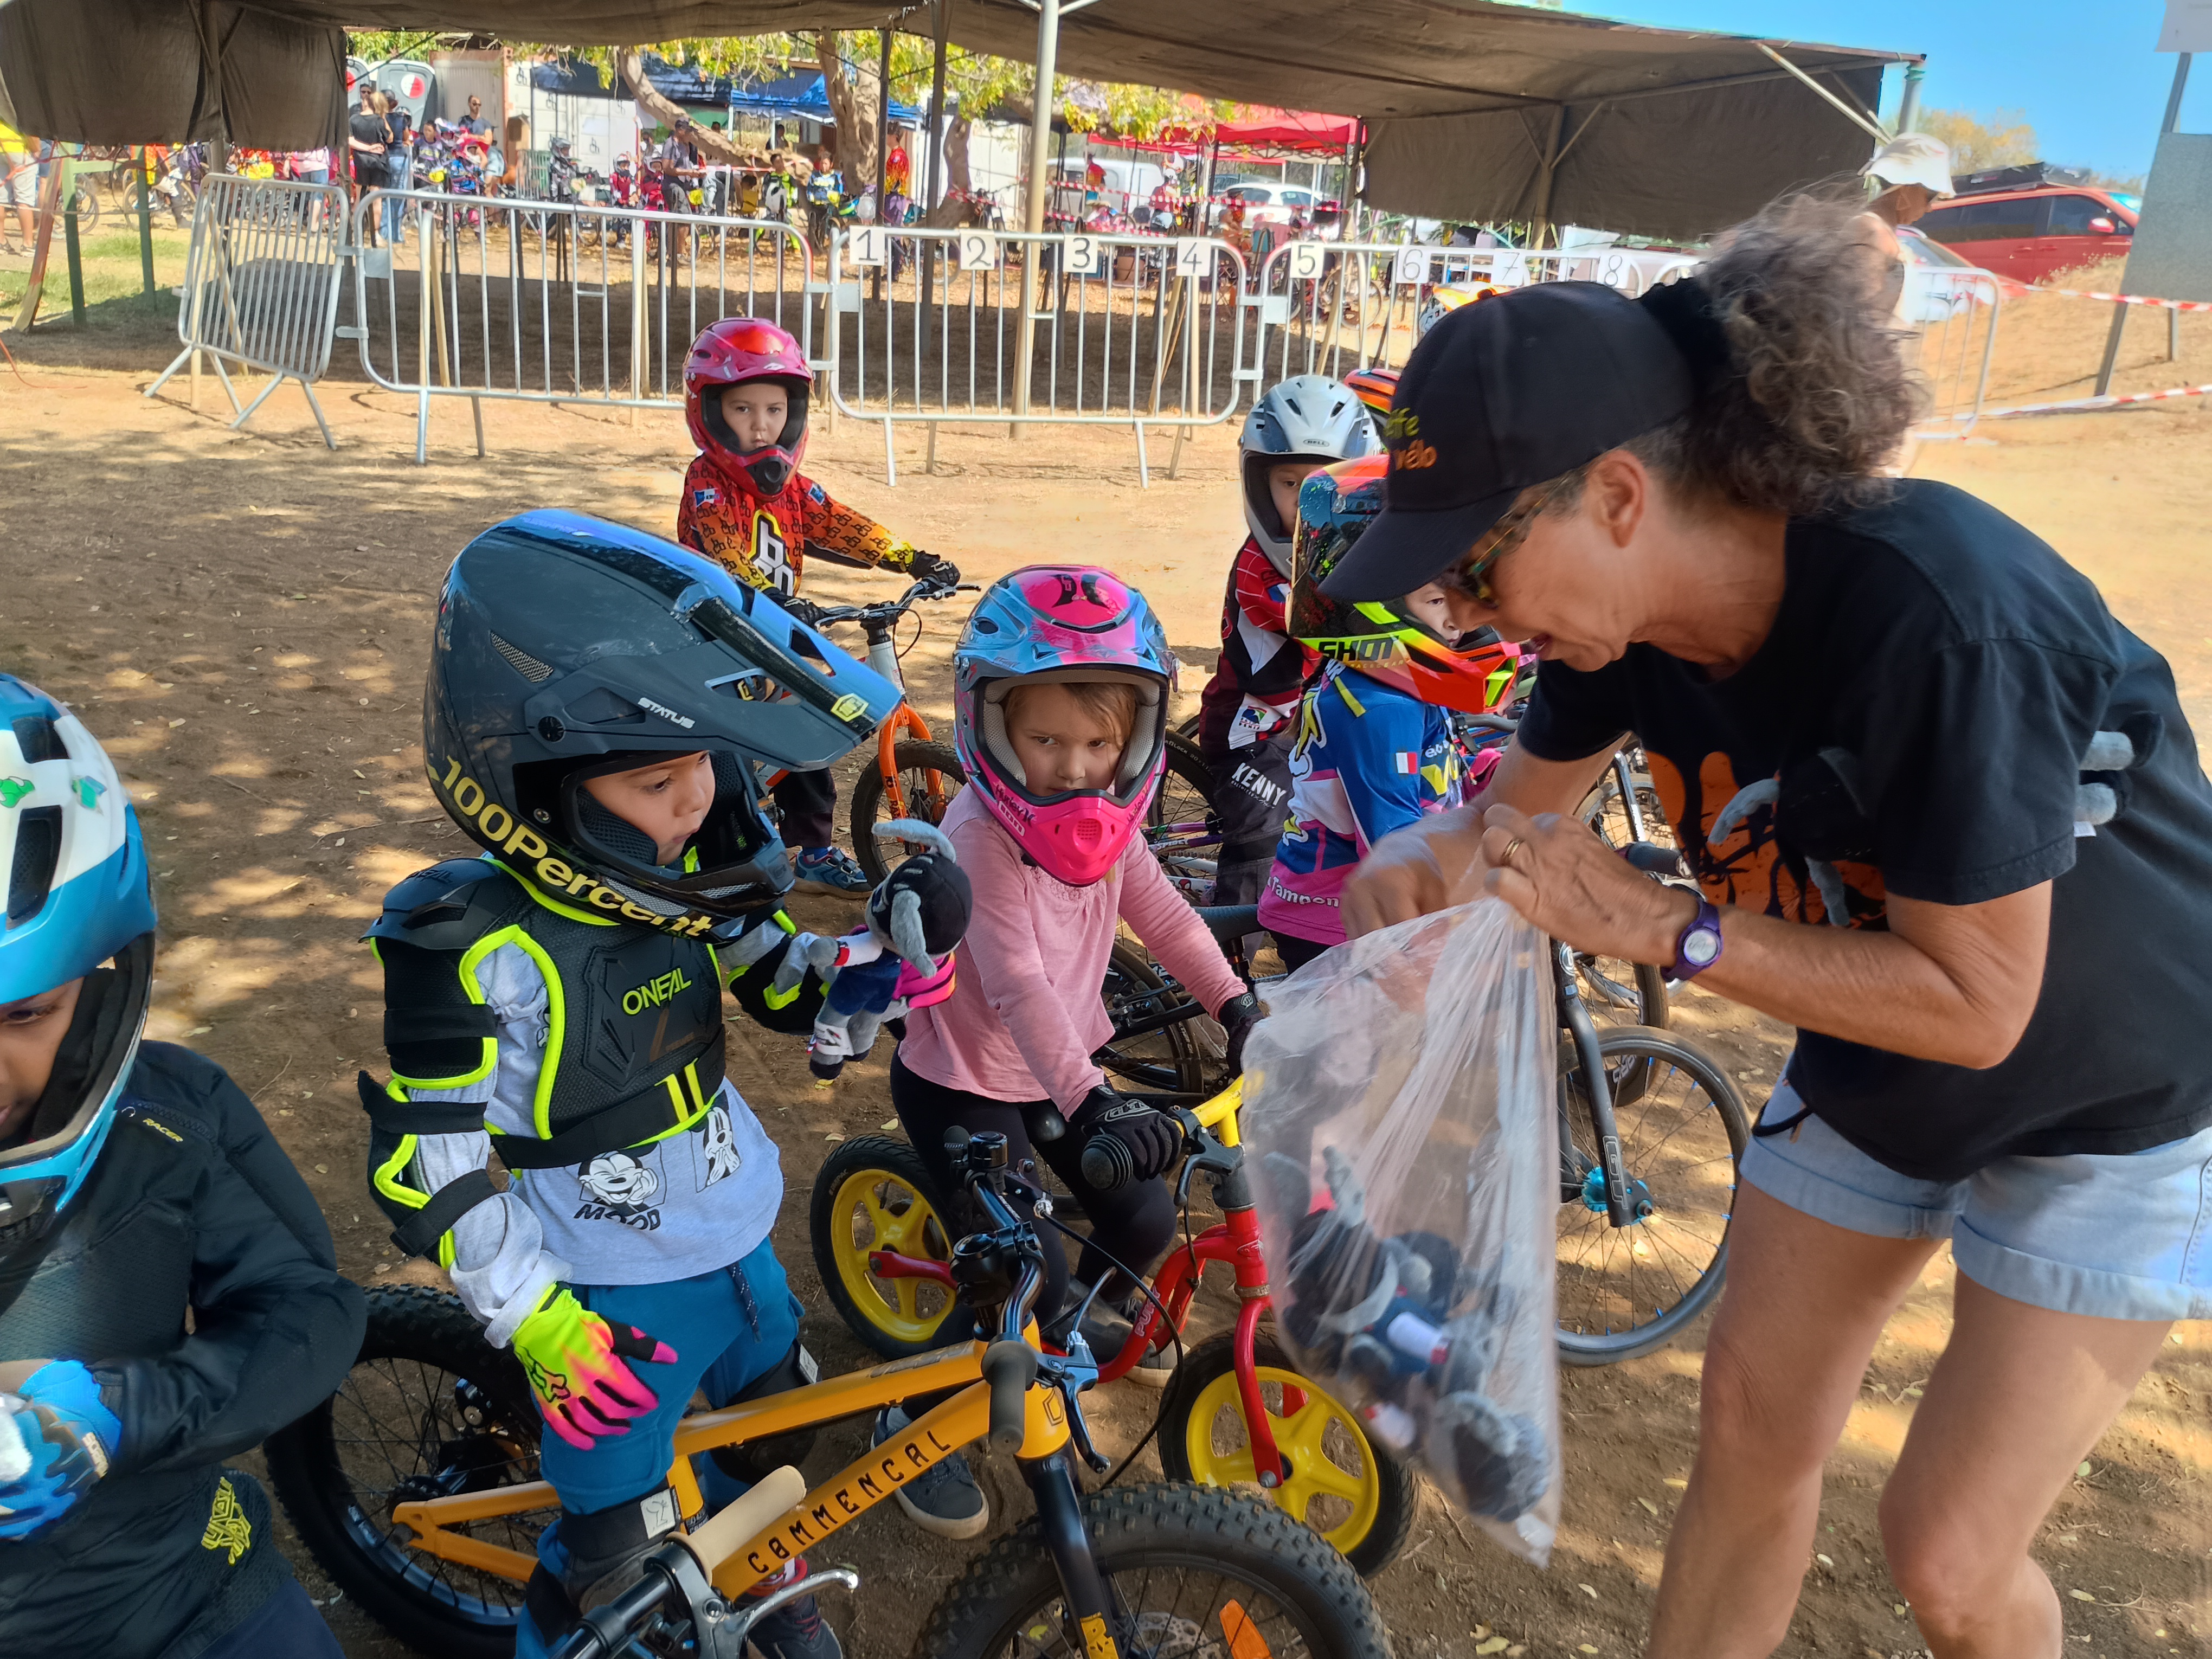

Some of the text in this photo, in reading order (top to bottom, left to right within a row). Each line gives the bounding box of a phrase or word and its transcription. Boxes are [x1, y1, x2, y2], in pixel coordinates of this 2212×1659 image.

[857, 229, 878, 261] 1
[967, 236, 992, 267] 2
[1072, 237, 1091, 269] 3
[1181, 242, 1203, 274] 4
[1297, 245, 1316, 276] 5
[1402, 248, 1423, 281] 6
[1502, 252, 1520, 281] 7
[1604, 254, 1623, 287] 8
[1318, 635, 1400, 663] SHOT
[638, 697, 696, 729] STATUS
[1231, 762, 1287, 806] KENNY
[442, 755, 713, 937] 100Percent
[1271, 876, 1340, 907] Tampon
[142, 1117, 184, 1143] RACER
[573, 1203, 661, 1231] MOOD
